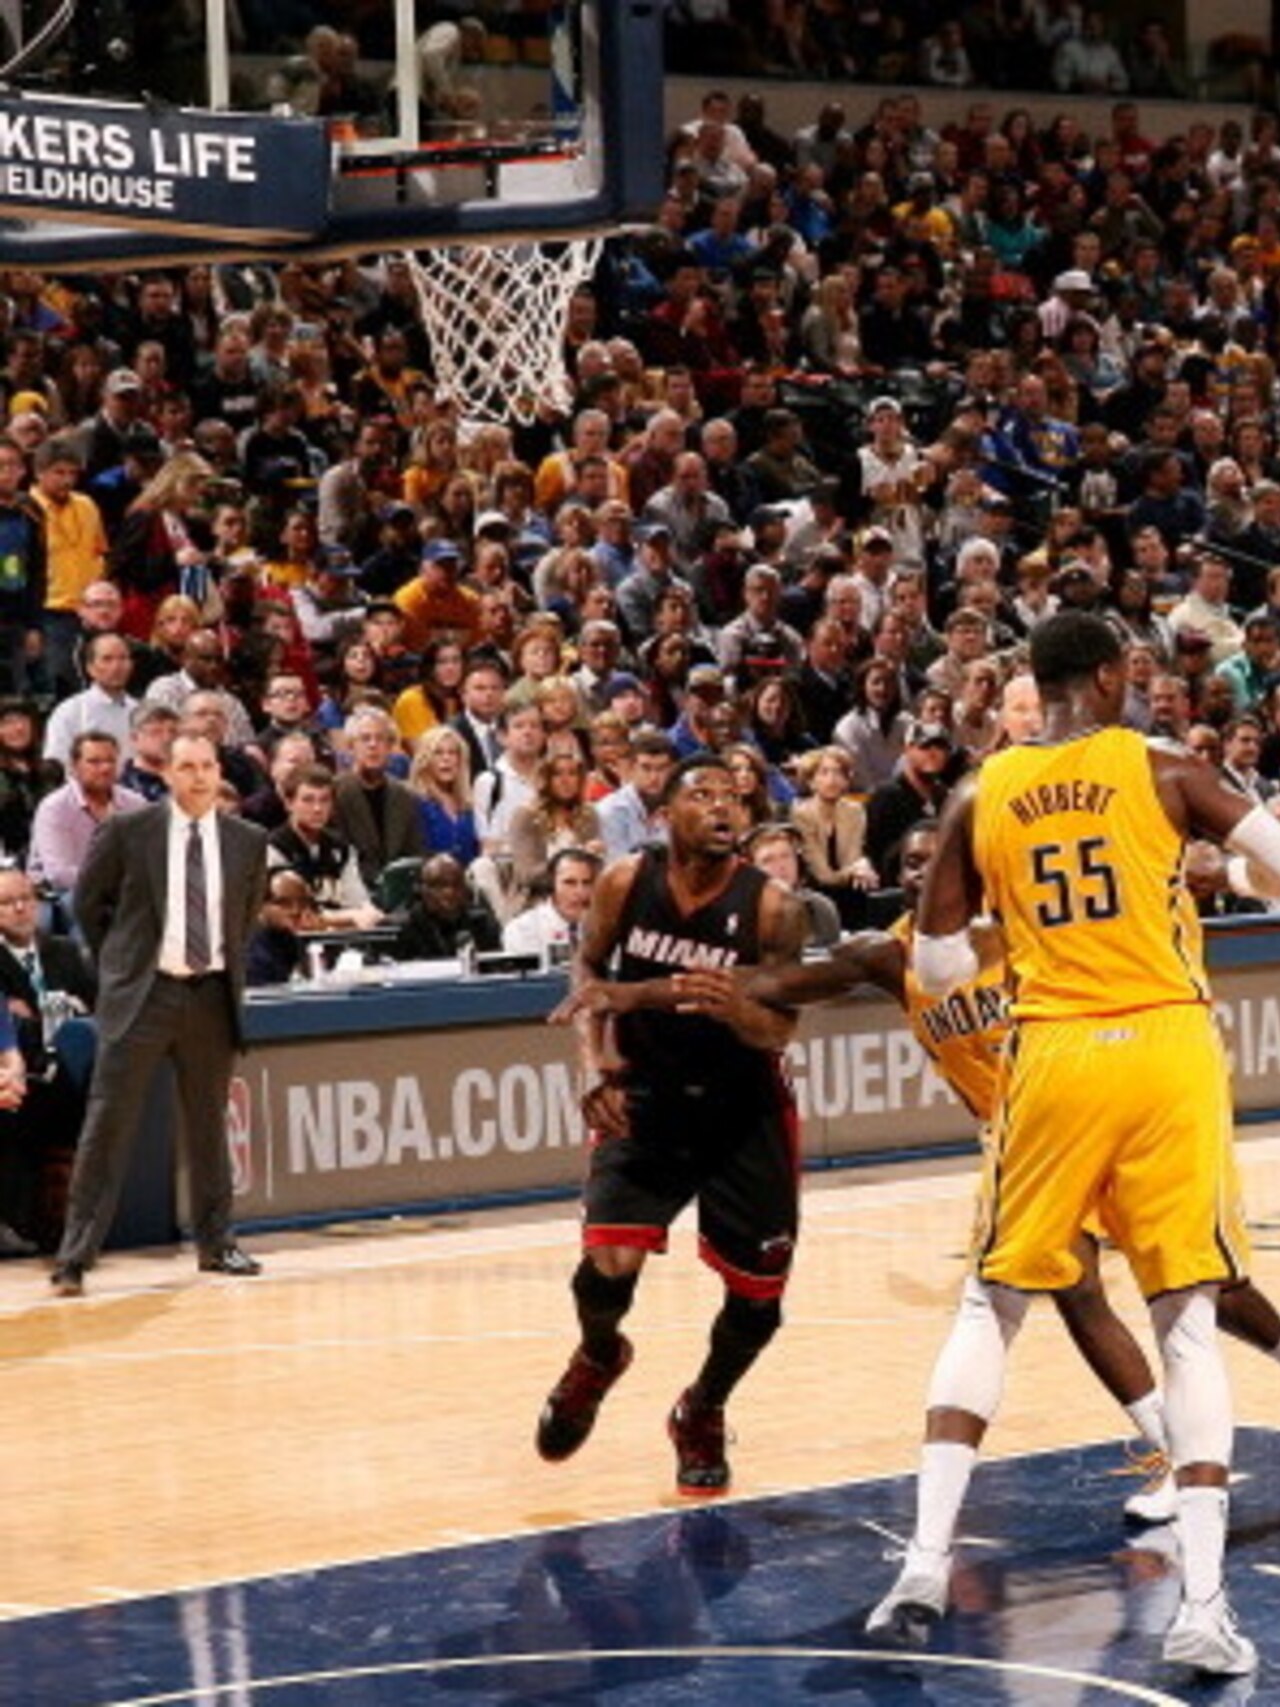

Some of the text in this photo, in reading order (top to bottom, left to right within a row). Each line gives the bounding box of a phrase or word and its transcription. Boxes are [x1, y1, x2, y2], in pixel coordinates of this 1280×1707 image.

[0, 111, 257, 182] KERS LIFE
[1008, 779, 1118, 828] HIBBERT
[1032, 836, 1121, 928] 55
[625, 925, 739, 970] MIAMI
[286, 1063, 603, 1175] NBA.COM
